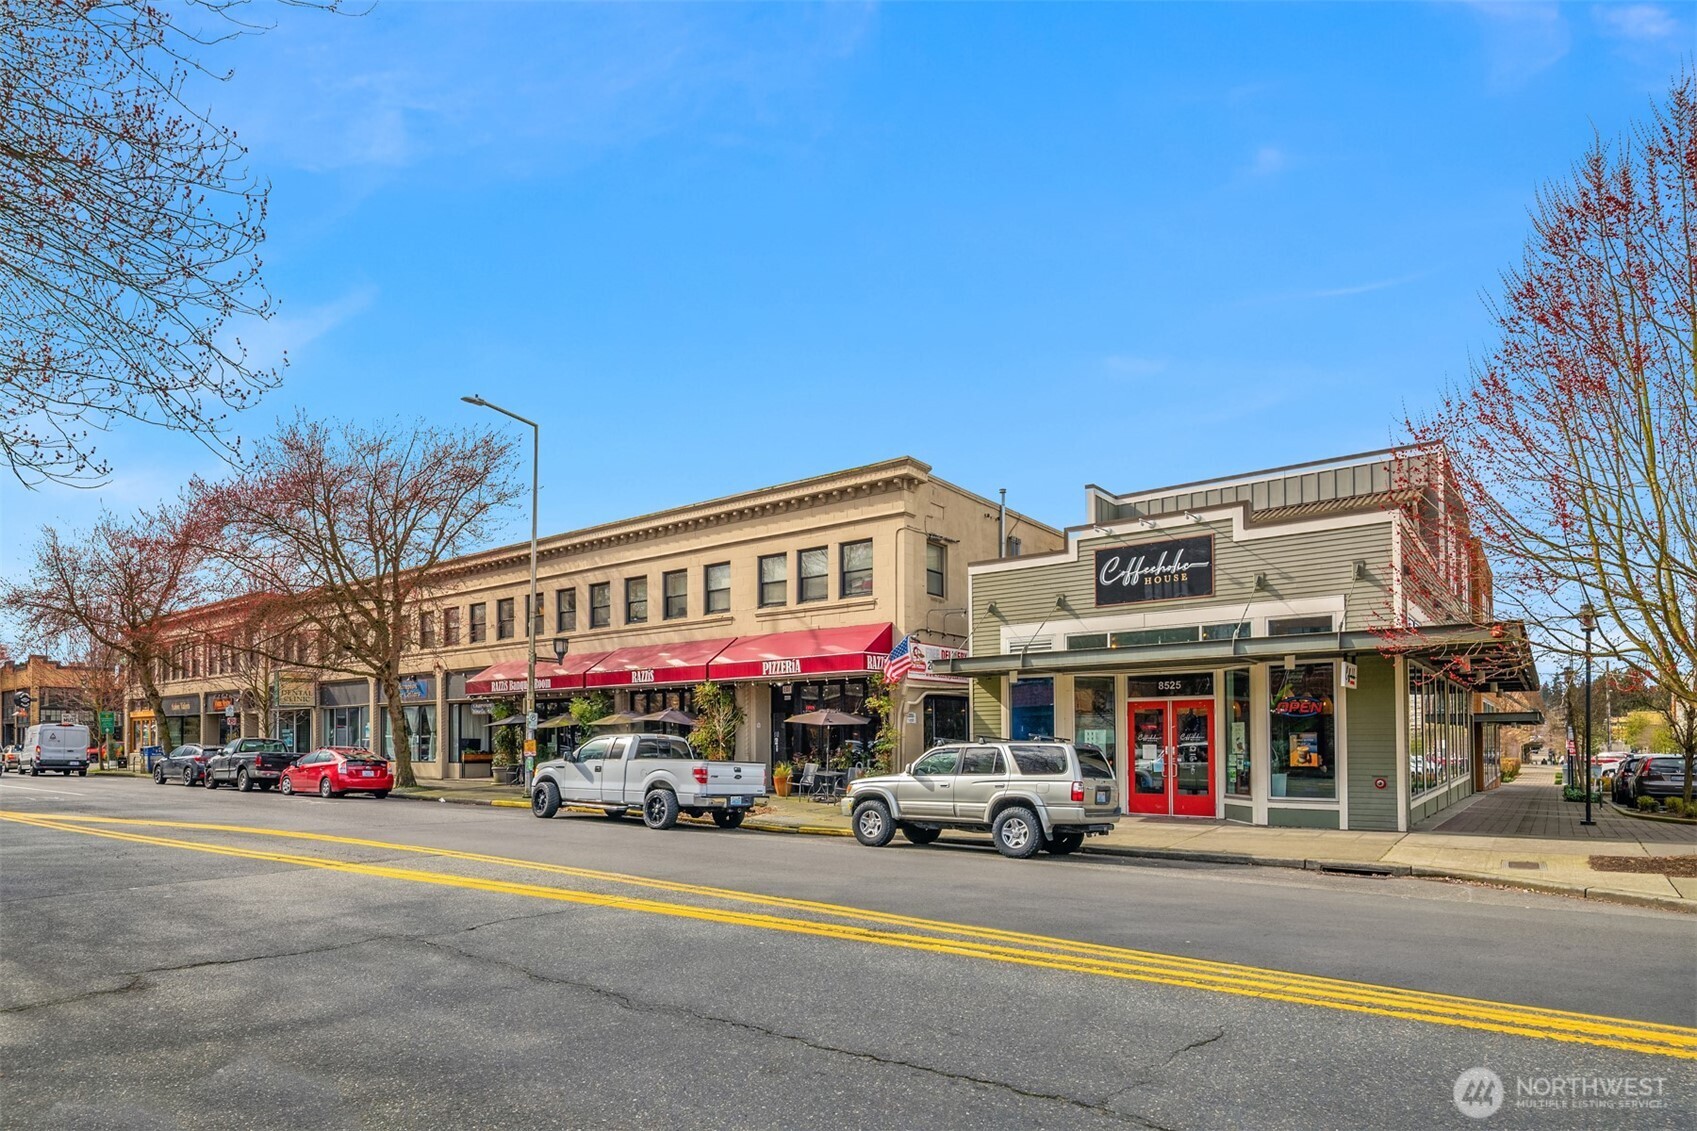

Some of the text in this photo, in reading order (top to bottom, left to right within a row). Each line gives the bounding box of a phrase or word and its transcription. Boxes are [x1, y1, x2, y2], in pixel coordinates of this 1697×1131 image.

[1144, 573, 1188, 585] HOUSE
[1158, 680, 1182, 690] 8525
[281, 689, 312, 697] DENTAL
[1276, 700, 1323, 714] OPEN
